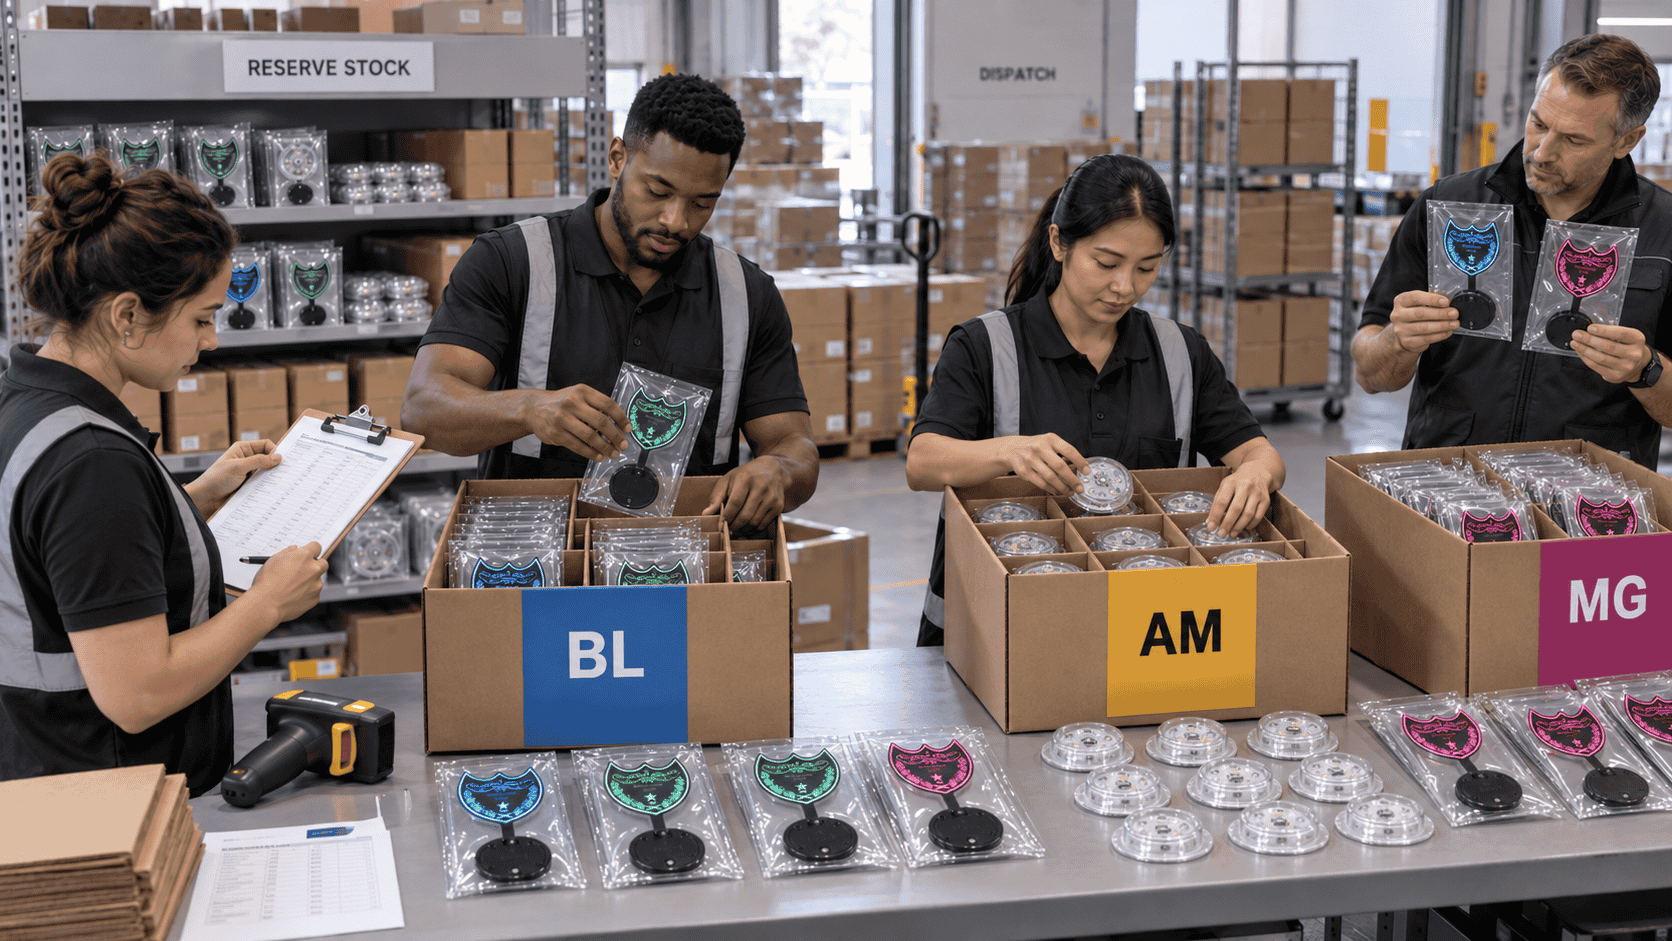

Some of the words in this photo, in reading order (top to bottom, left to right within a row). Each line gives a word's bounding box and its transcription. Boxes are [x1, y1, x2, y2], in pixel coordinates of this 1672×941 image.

[248, 59, 337, 76] RESERVE
[344, 59, 411, 76] STOCK
[979, 66, 1057, 81] DISPATCH
[1569, 574, 1647, 624] MG
[568, 630, 645, 679] BL
[1139, 608, 1222, 657] AM
